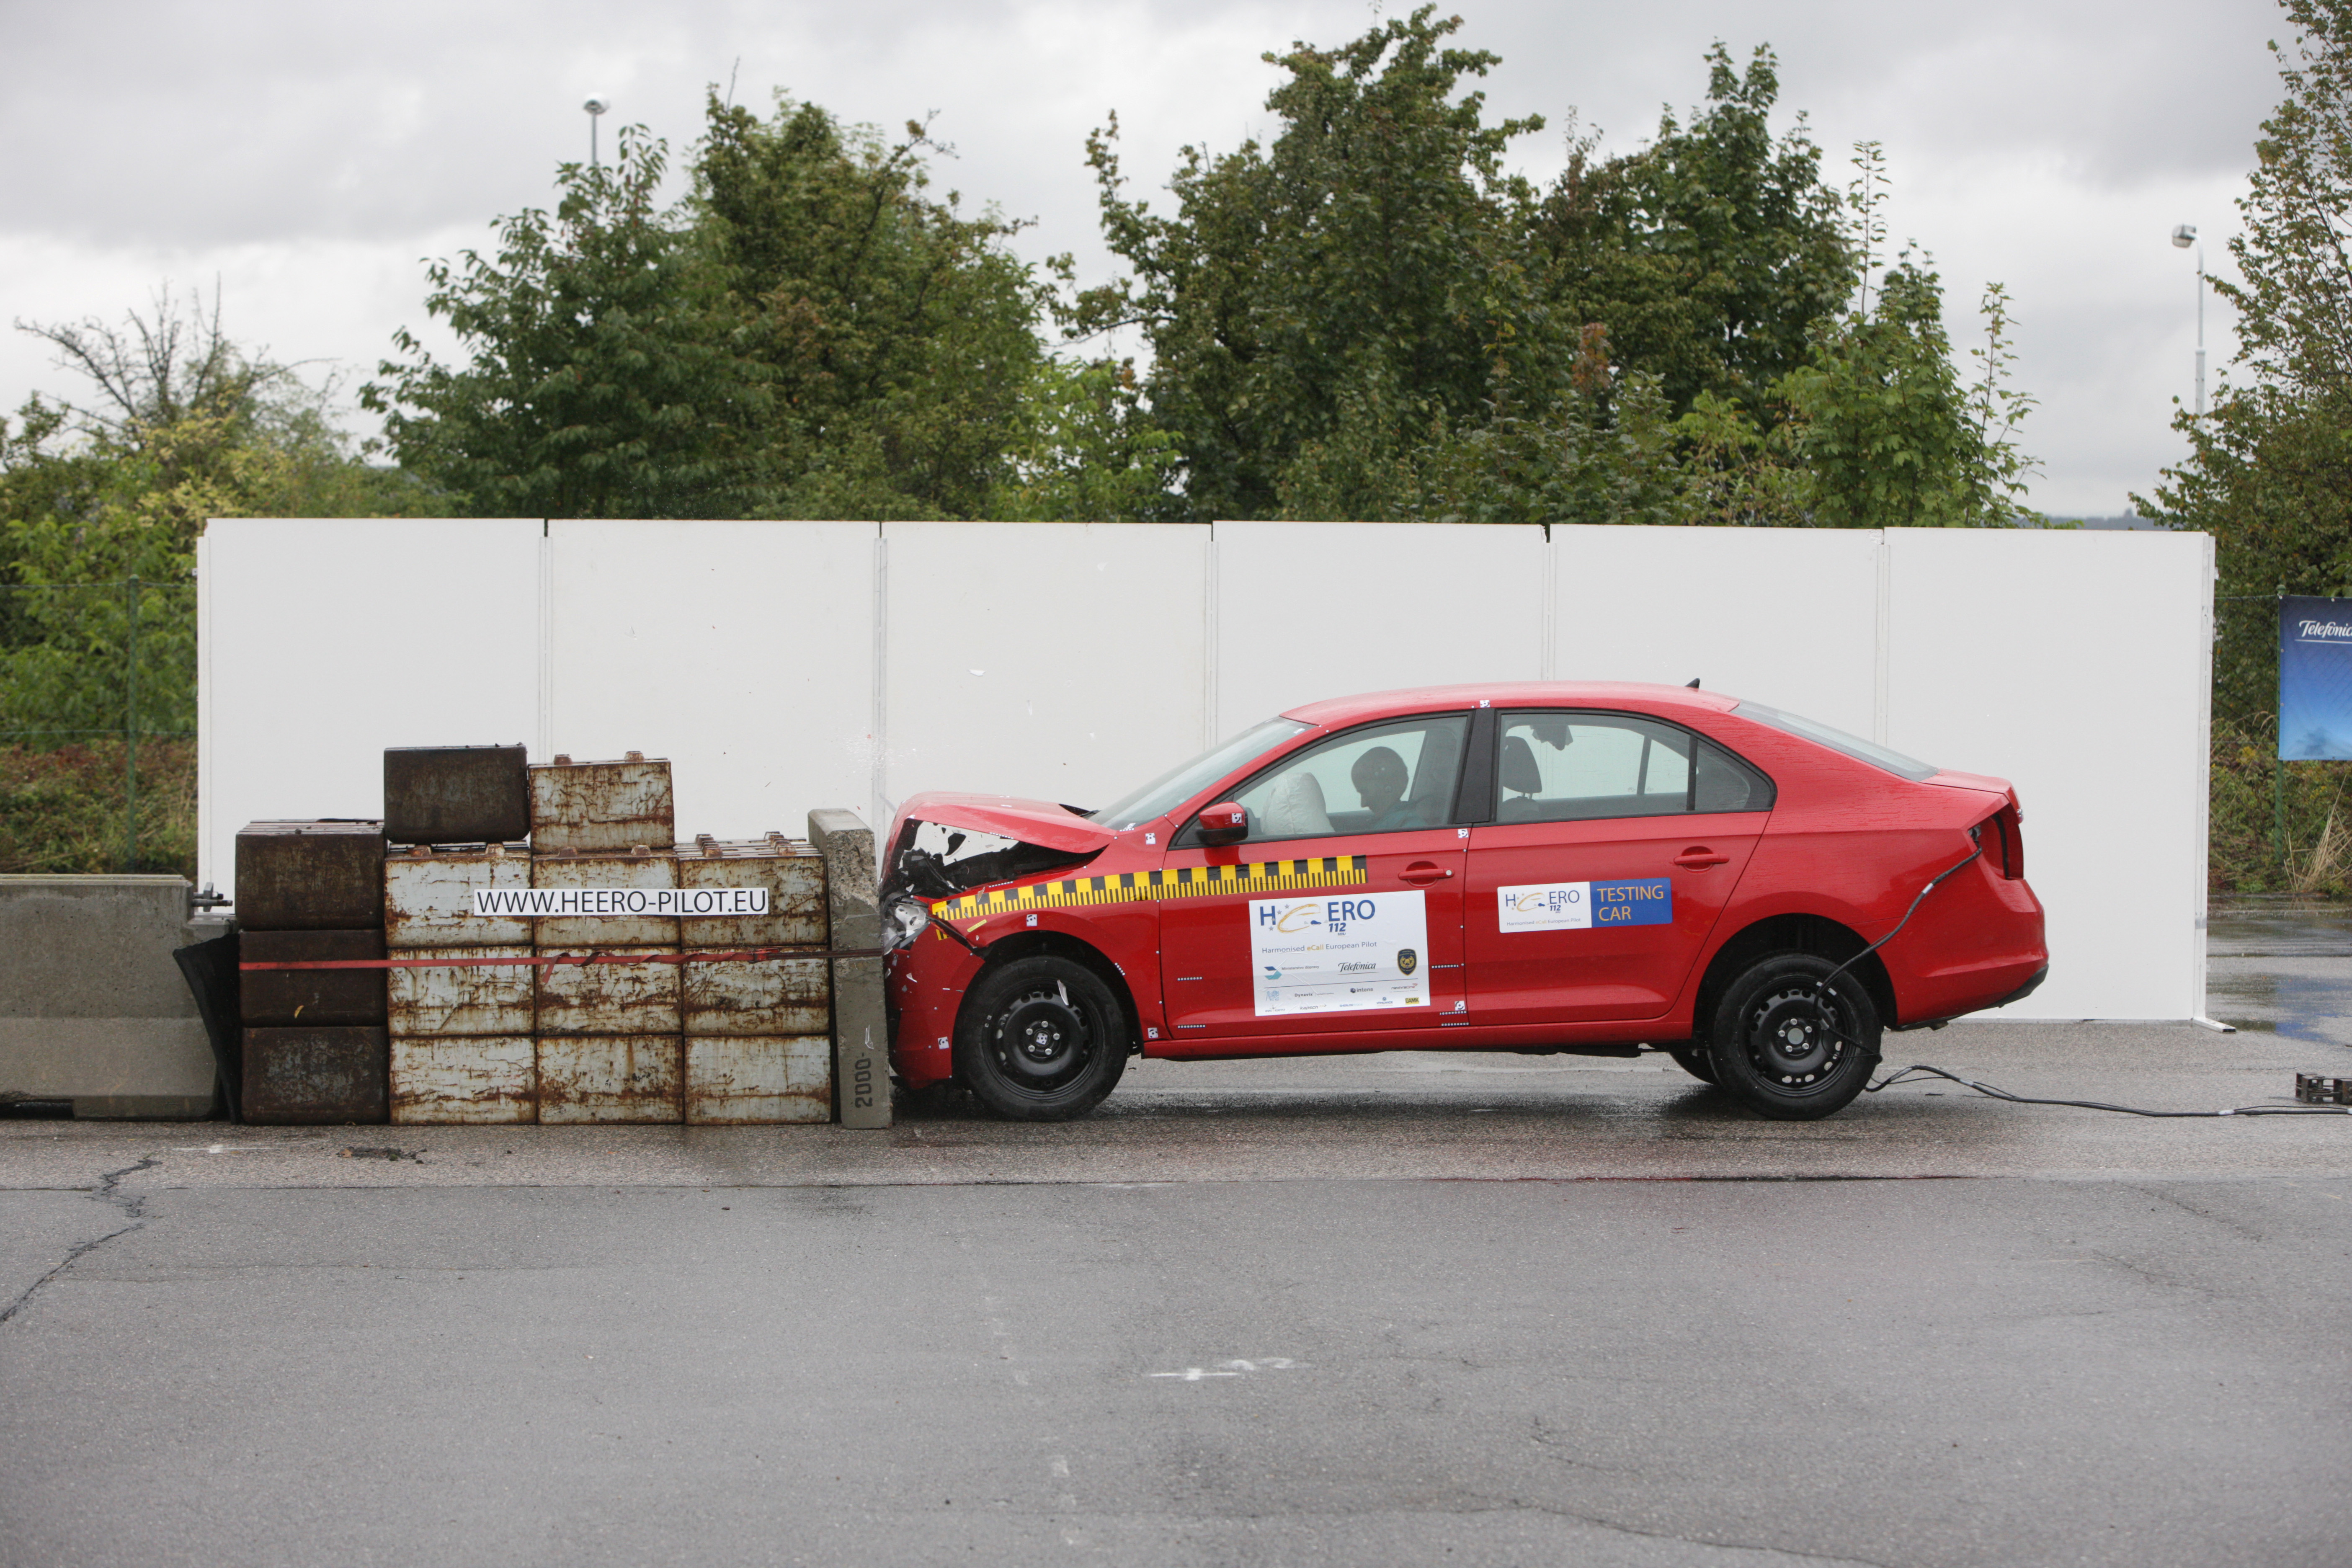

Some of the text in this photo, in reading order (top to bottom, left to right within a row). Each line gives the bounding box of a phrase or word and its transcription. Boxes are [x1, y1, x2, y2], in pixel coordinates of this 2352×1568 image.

[477, 890, 766, 913] WWW.HEERO-PILOT.EU
[1597, 885, 1664, 902] TESTING
[1599, 906, 1631, 921] CAR
[1329, 922, 1346, 932] 112
